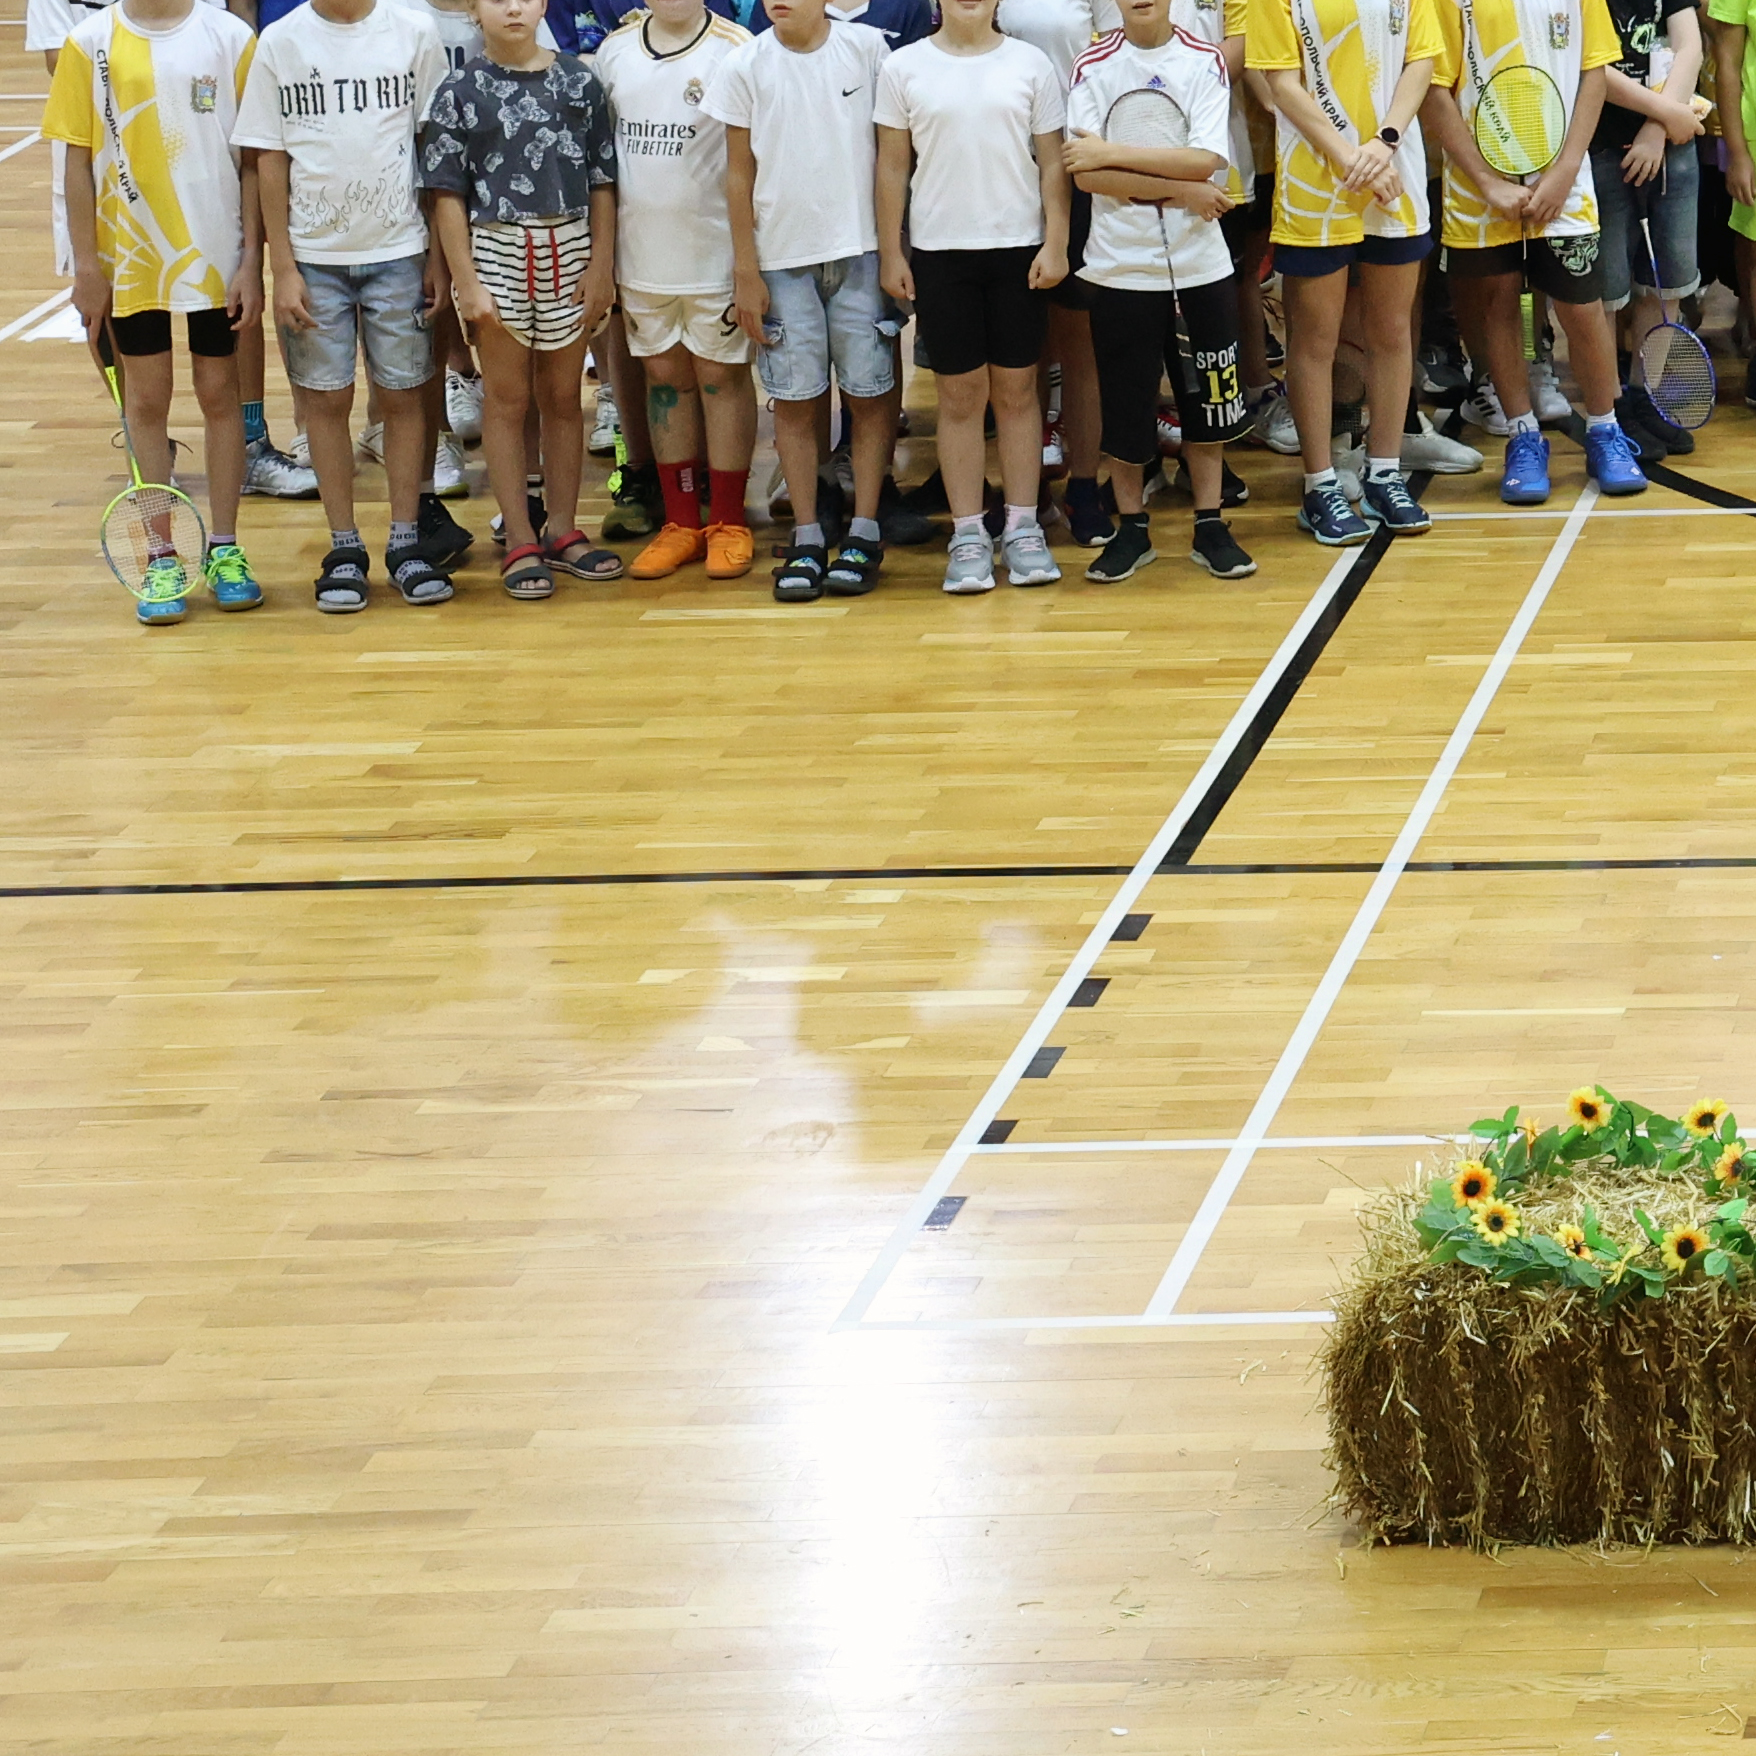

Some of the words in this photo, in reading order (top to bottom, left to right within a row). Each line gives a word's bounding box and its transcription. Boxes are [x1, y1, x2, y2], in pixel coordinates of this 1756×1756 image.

[280, 76, 327, 119] ORN
[620, 119, 697, 140] Emirates
[1321, 100, 1348, 133] КРАЙ
[627, 139, 642, 155] FLY
[642, 140, 684, 157] BETTER
[1205, 364, 1239, 404] 13
[1201, 394, 1247, 428] TIME
